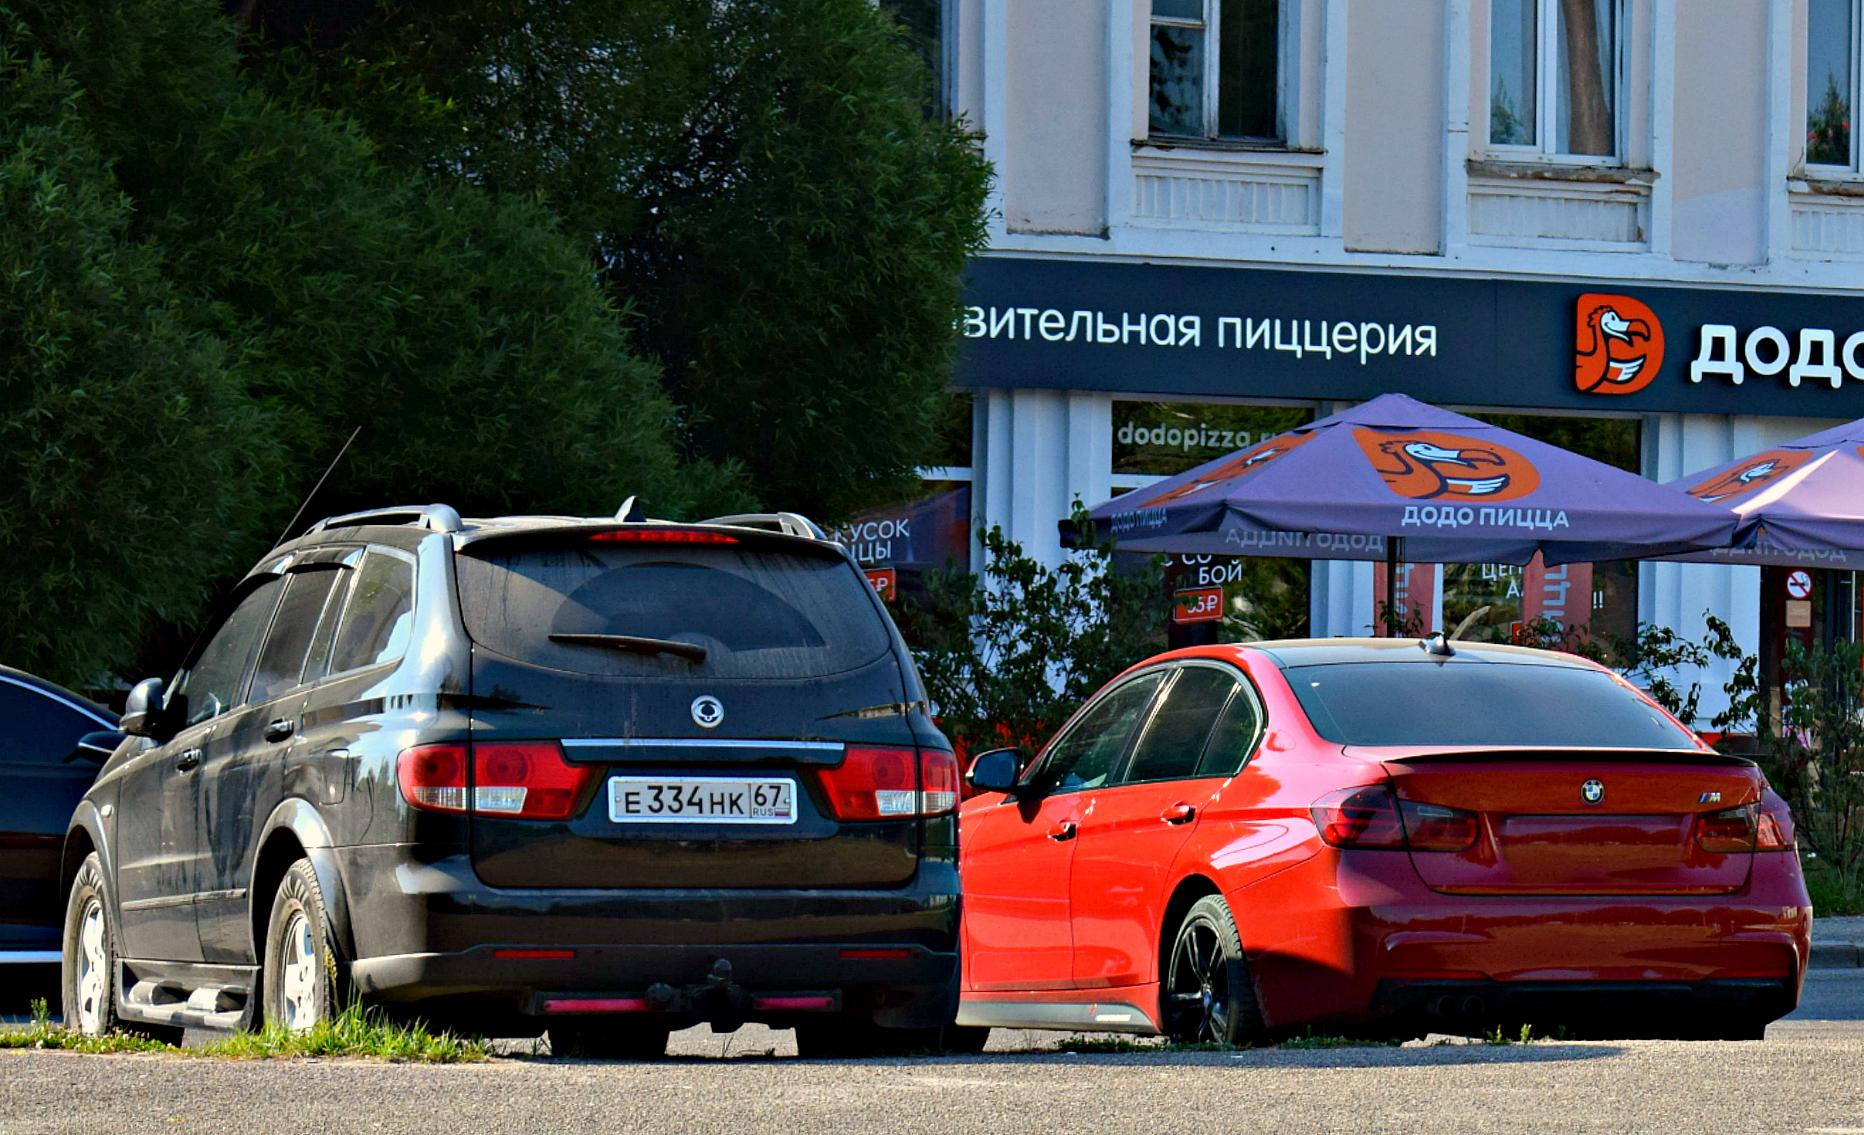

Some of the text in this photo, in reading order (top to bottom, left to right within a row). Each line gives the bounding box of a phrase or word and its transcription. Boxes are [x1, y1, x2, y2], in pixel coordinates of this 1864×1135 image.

[951, 304, 1437, 366] вительная пиццерия
[1401, 506, 1569, 531] ДОДО ПИЦЦА
[1198, 559, 1242, 585] БОЙ
[624, 785, 782, 815] Е334НК 67
[752, 807, 774, 817] RUS
